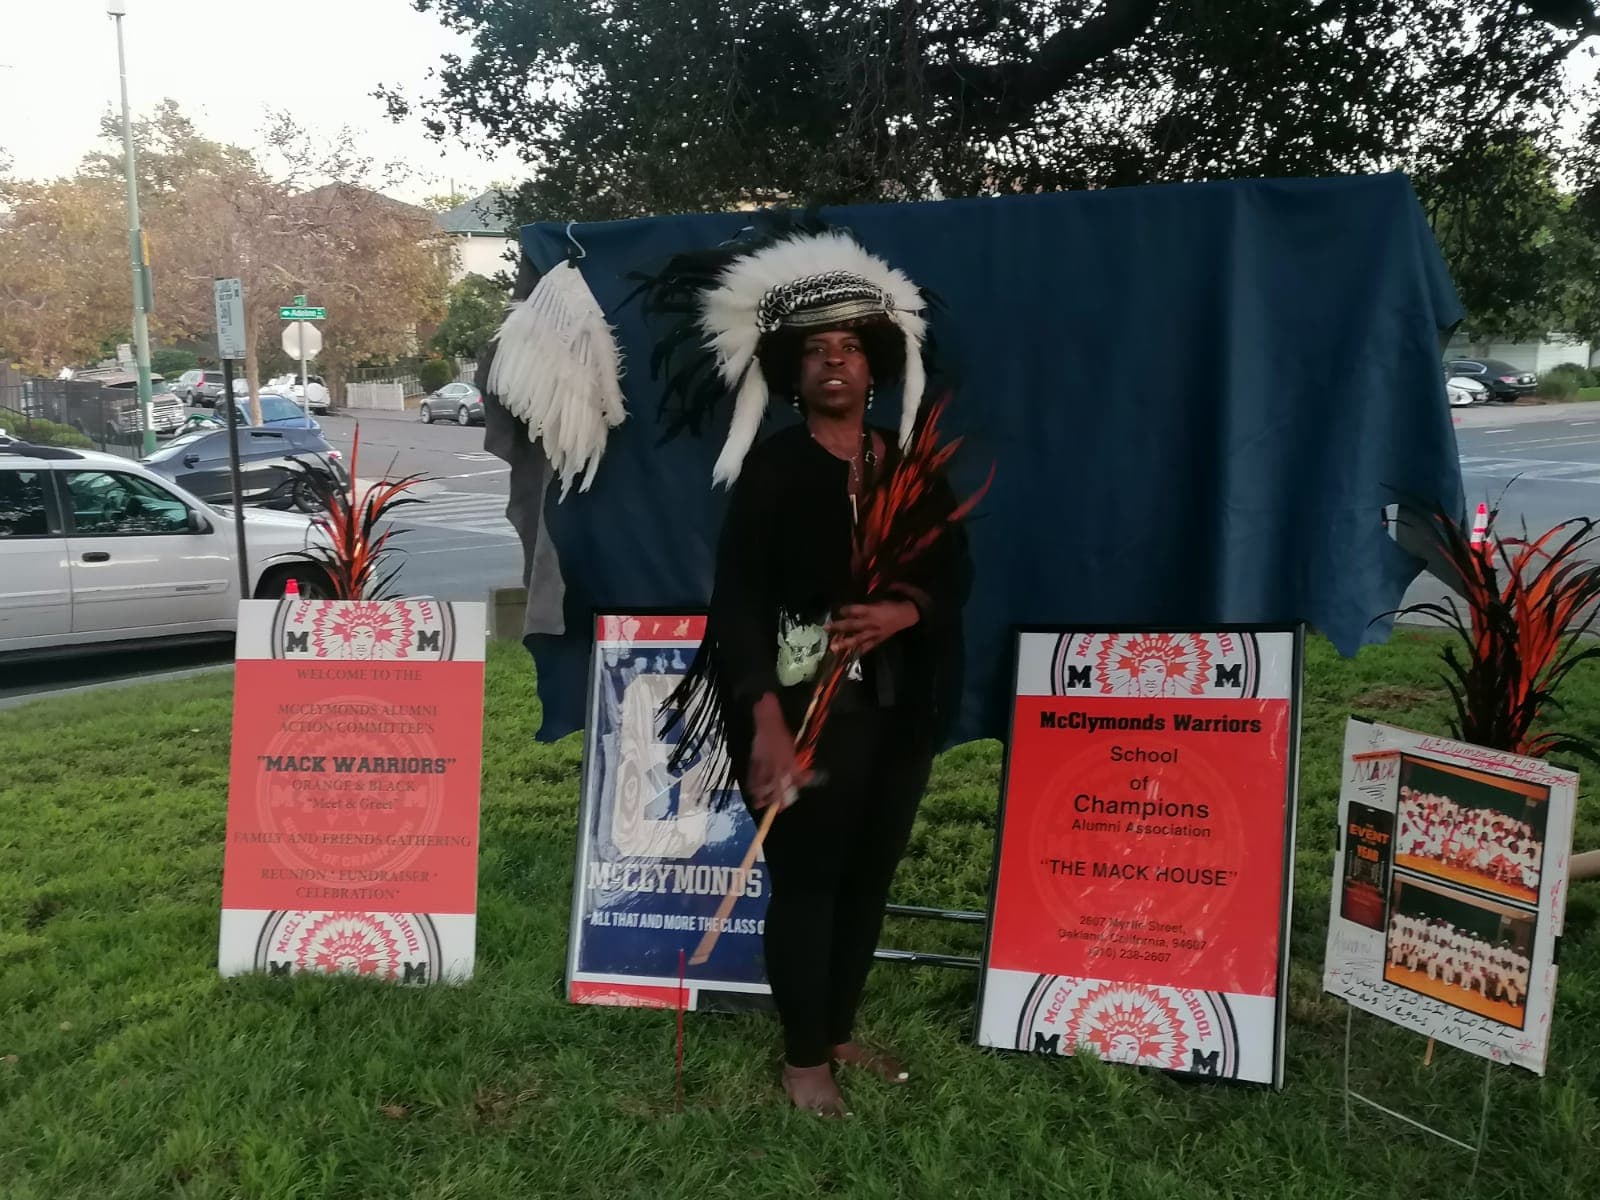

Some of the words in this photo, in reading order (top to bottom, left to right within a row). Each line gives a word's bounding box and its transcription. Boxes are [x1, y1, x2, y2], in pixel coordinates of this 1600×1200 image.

[286, 631, 309, 652] M
[417, 630, 441, 651] M
[297, 668, 367, 681] WELCOME
[372, 669, 390, 681] TO
[393, 669, 422, 681] THE
[1067, 665, 1092, 688] M
[1215, 664, 1242, 688] M
[383, 705, 437, 717] ALUMNI
[280, 721, 334, 733] ACTION
[1040, 711, 1166, 733] McClymonds
[1173, 714, 1262, 733] Warriors
[1110, 746, 1178, 764] School
[292, 779, 354, 791] ORANGE
[357, 780, 366, 791] &
[369, 780, 416, 792] BLACK
[1130, 775, 1149, 791] of
[345, 799, 356, 809] &
[1074, 794, 1210, 821] Champions
[1072, 818, 1121, 833] Alumni
[1125, 822, 1211, 838] Association
[233, 832, 282, 844] FAMILY
[287, 832, 319, 844] AND
[321, 832, 385, 845] FRIENDS
[386, 834, 471, 847] GATHERING
[261, 868, 325, 881] REUNION
[339, 869, 429, 882] FUNDRAISER
[1092, 862, 1149, 881] MACK
[612, 912, 638, 928] THAT
[638, 914, 664, 929] AND
[664, 914, 697, 931] MORE
[698, 916, 720, 932] THE
[720, 917, 756, 934] CLASS
[403, 961, 427, 985] M
[1033, 1032, 1060, 1056] M
[1191, 1048, 1220, 1077] M
